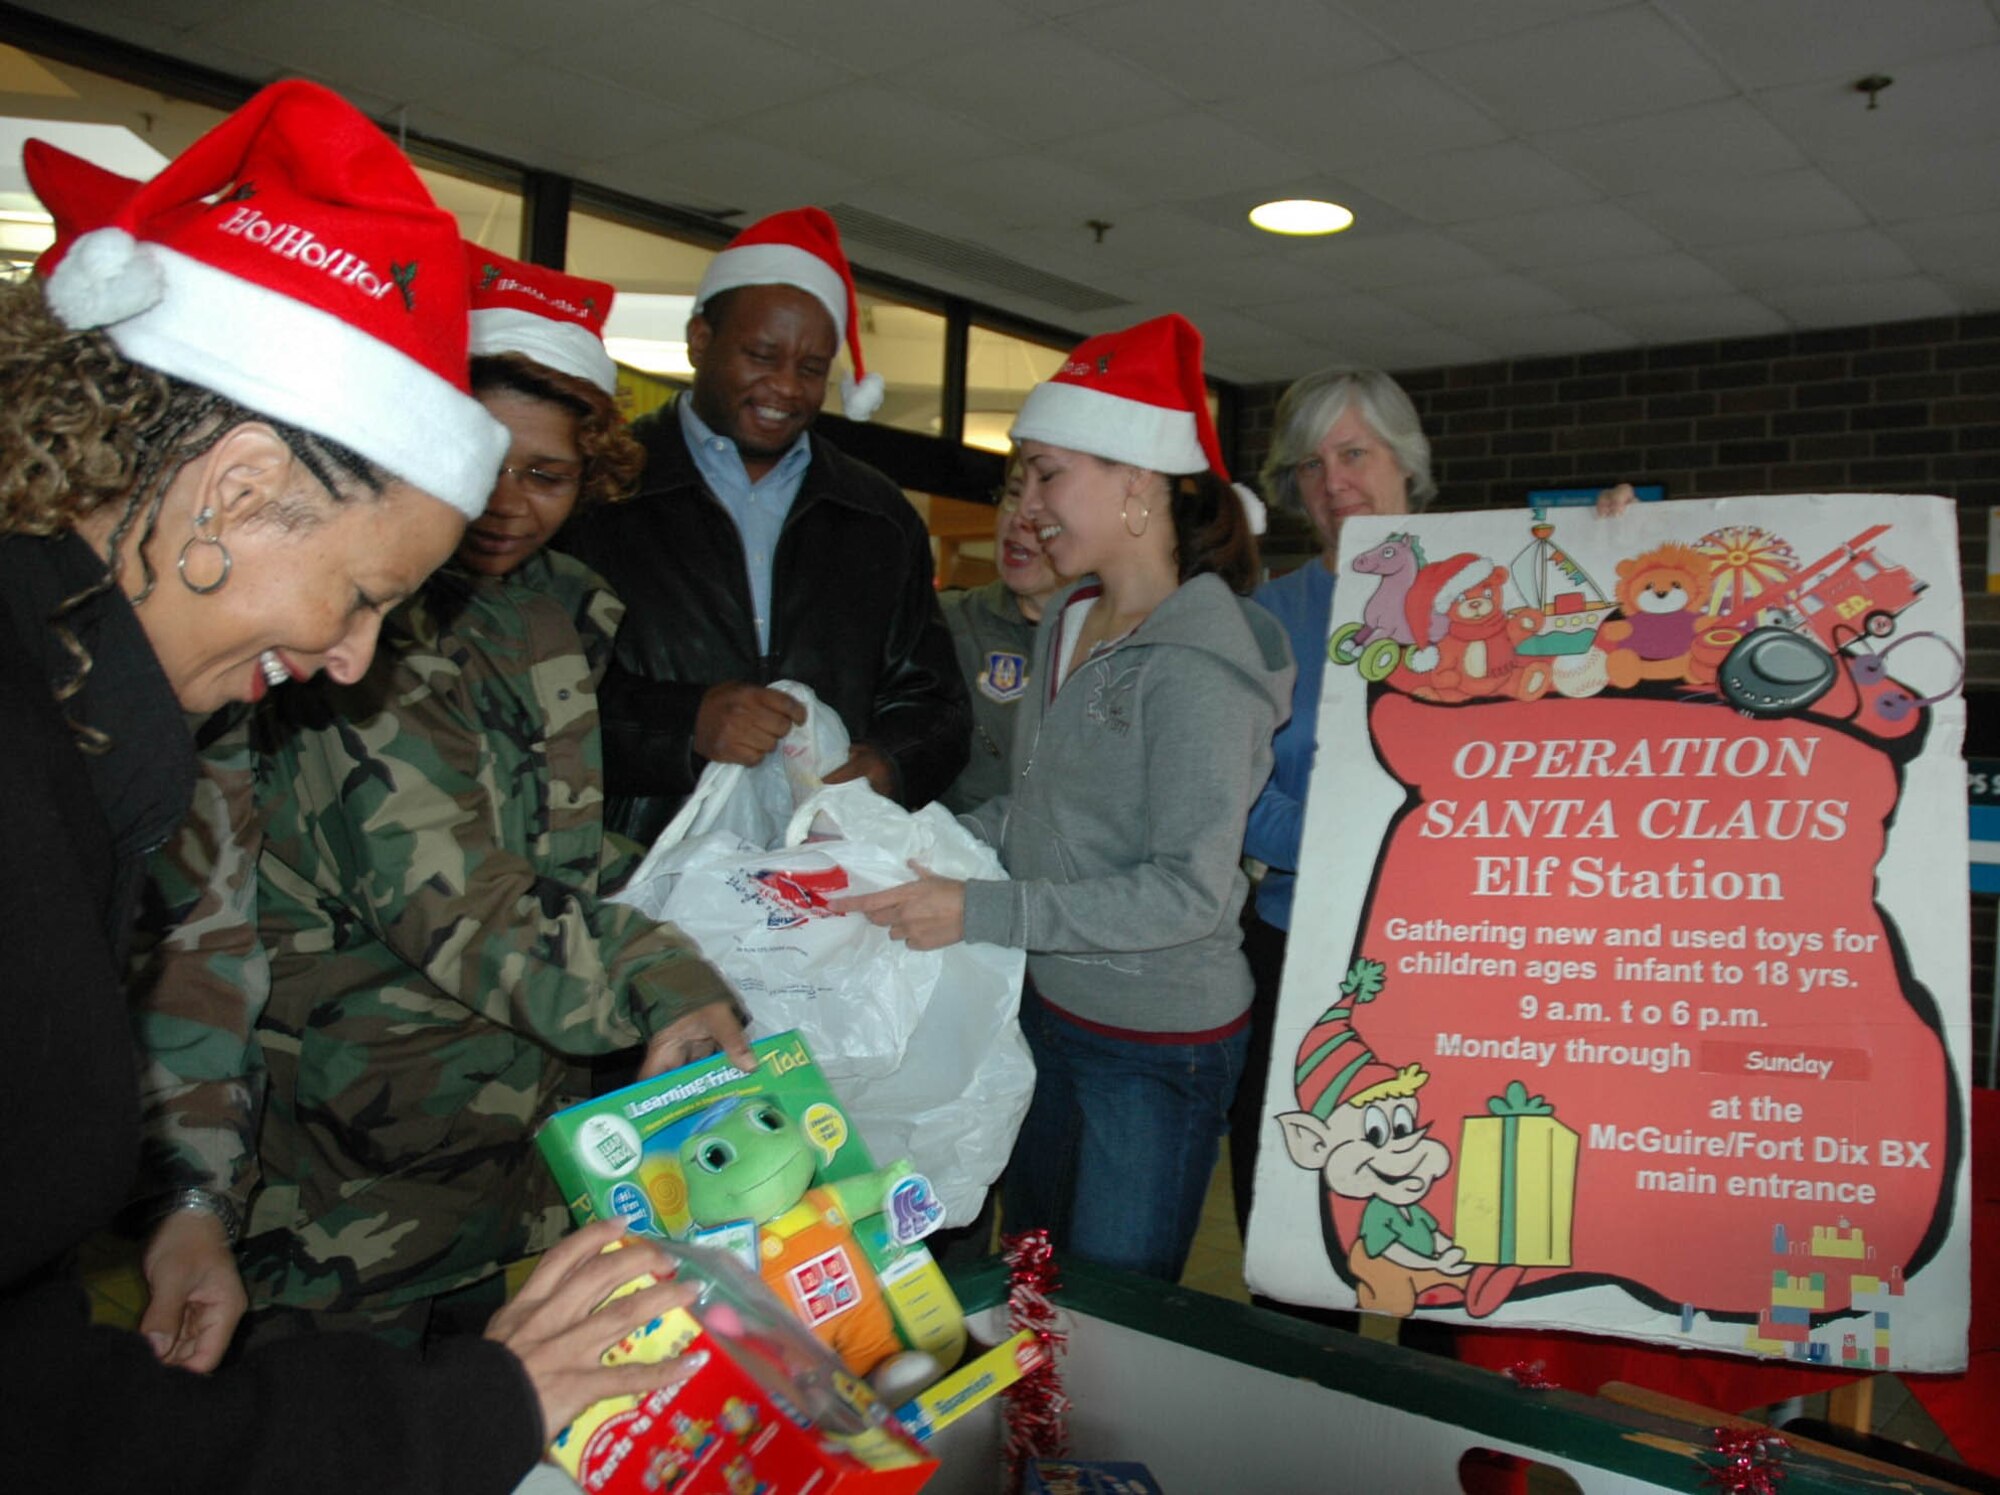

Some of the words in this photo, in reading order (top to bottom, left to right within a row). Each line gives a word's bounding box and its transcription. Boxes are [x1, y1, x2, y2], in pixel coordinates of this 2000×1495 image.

[1452, 736, 1820, 780] OPERATION
[1418, 798, 1620, 840] SANTA
[1637, 797, 1850, 842] CLAUS
[1470, 855, 1561, 897] Elf
[1567, 855, 1785, 901] Station
[1384, 917, 1527, 951] Gathering
[1534, 925, 1598, 946] new
[1604, 922, 1662, 948] and
[1670, 924, 1747, 950] used
[1754, 927, 1824, 958] toys
[1832, 927, 1880, 953] for
[1397, 950, 1517, 977] children
[1523, 959, 1598, 985] ages
[1613, 956, 1705, 984] infant
[1711, 960, 1744, 985] to
[1754, 960, 1790, 986] 18
[1797, 967, 1859, 993] yrs.
[1518, 994, 1539, 1020] 9
[1546, 1001, 1612, 1024] a.m.
[1669, 999, 1691, 1026] 6
[1698, 1007, 1769, 1032] p.m.
[1434, 1032, 1558, 1068] Monday
[1563, 1037, 1692, 1074] through
[1744, 1050, 1834, 1080] Sunday
[1708, 1095, 1742, 1121] at
[1749, 1095, 1803, 1124] the
[1588, 1122, 1805, 1163] McGuire/Fort
[1813, 1135, 1870, 1167] Dix
[1879, 1139, 1931, 1169] BX
[1635, 1164, 1717, 1195] main
[1725, 1173, 1876, 1205] entrance
